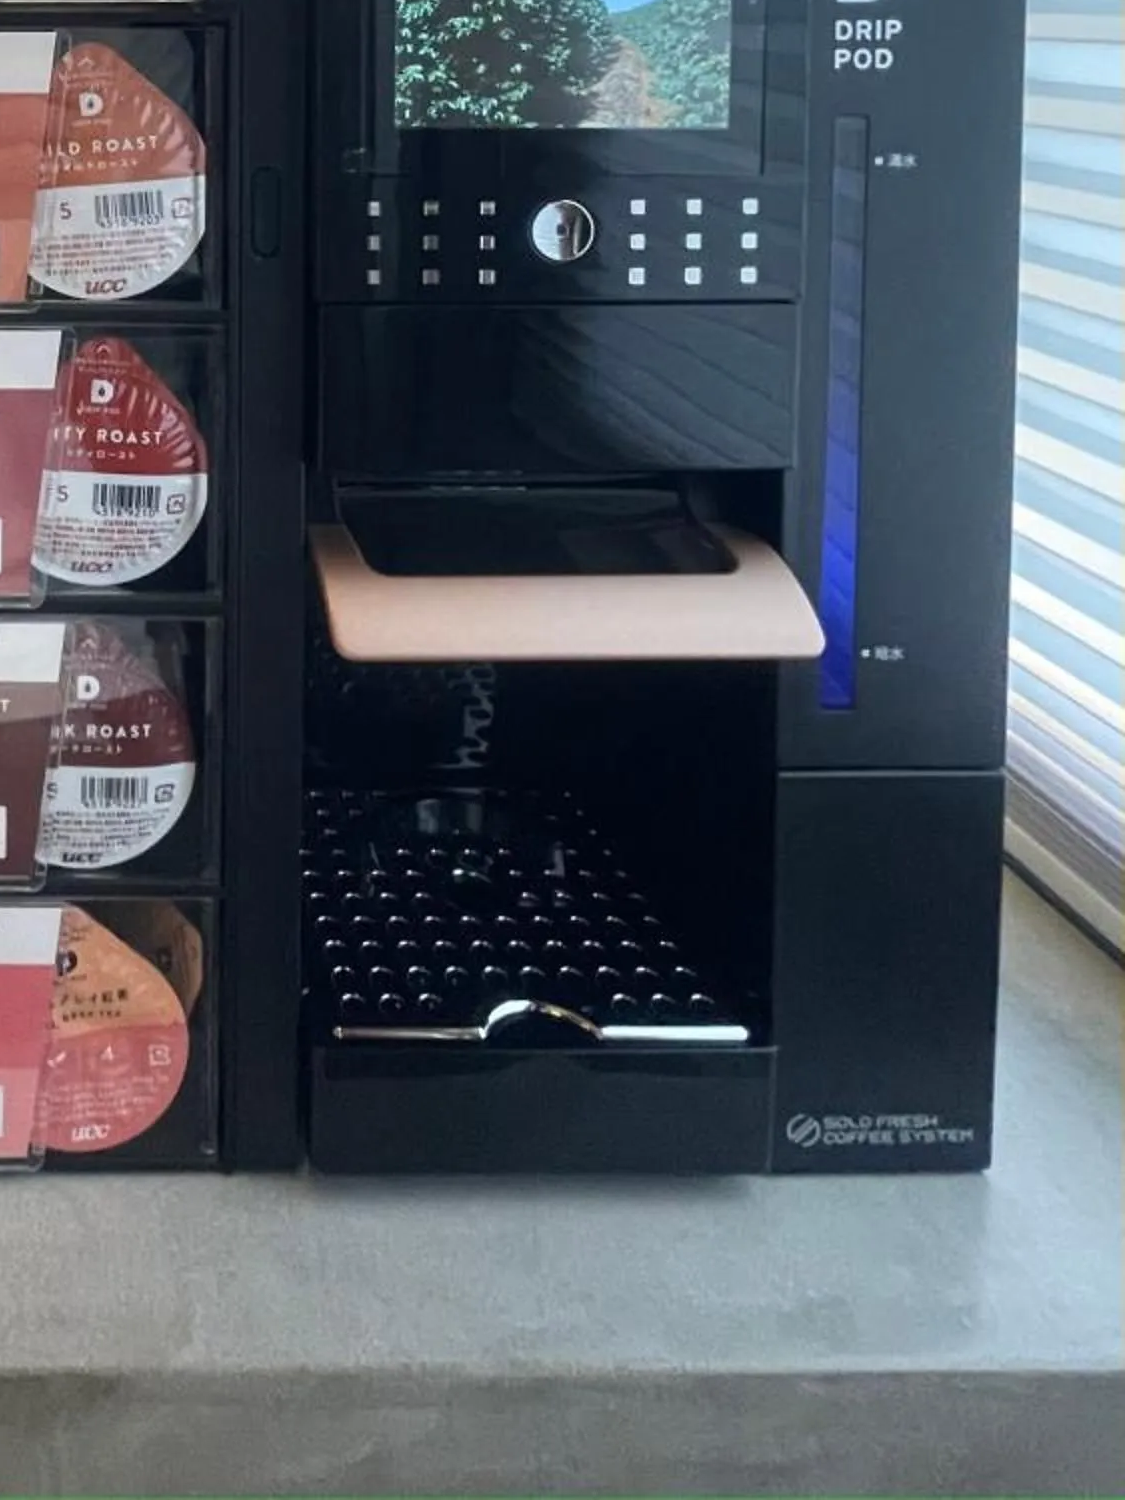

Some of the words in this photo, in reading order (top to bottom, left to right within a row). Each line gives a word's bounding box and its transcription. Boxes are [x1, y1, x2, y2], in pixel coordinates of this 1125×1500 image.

[834, 19, 904, 41] DRIP
[834, 48, 894, 70] POD
[92, 135, 157, 154] ROAST
[97, 427, 162, 445] ROAST
[86, 723, 152, 739] ROAST
[876, 1113, 939, 1129] FRESH
[823, 1129, 895, 1145] COFFEE
[899, 1128, 974, 1144] SYSTEM
